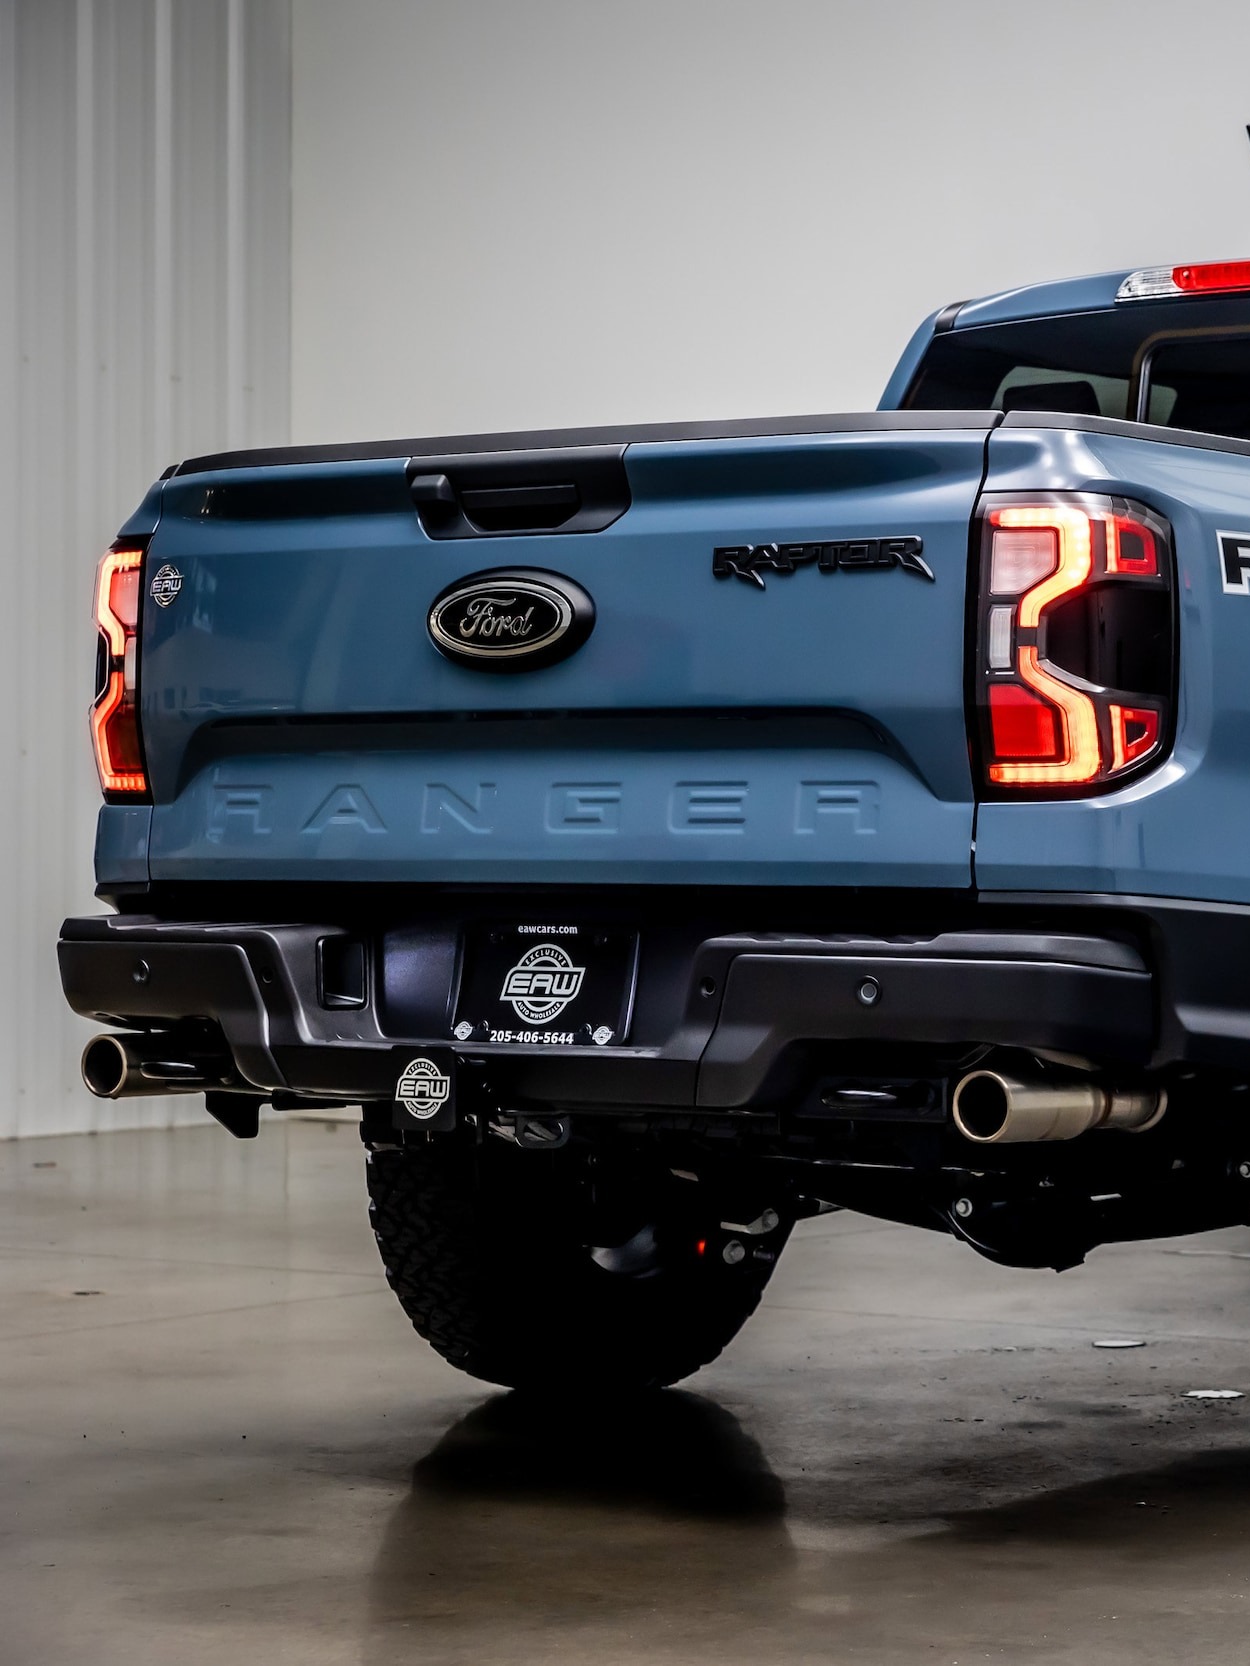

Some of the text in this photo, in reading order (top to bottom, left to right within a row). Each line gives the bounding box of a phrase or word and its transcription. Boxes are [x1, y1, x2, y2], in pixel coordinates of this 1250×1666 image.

[712, 534, 936, 590] RAPTOR
[152, 579, 182, 593] EAW
[459, 597, 535, 637] Ford
[209, 779, 880, 835] RANGER
[517, 924, 579, 935] eawcars.com
[525, 948, 567, 967] EXCLUSIVE
[507, 972, 578, 996] EAW
[517, 1001, 562, 1020] AUTO WHOLESALE
[489, 1029, 575, 1045] 205-406-5644
[399, 1079, 447, 1098] EAW
